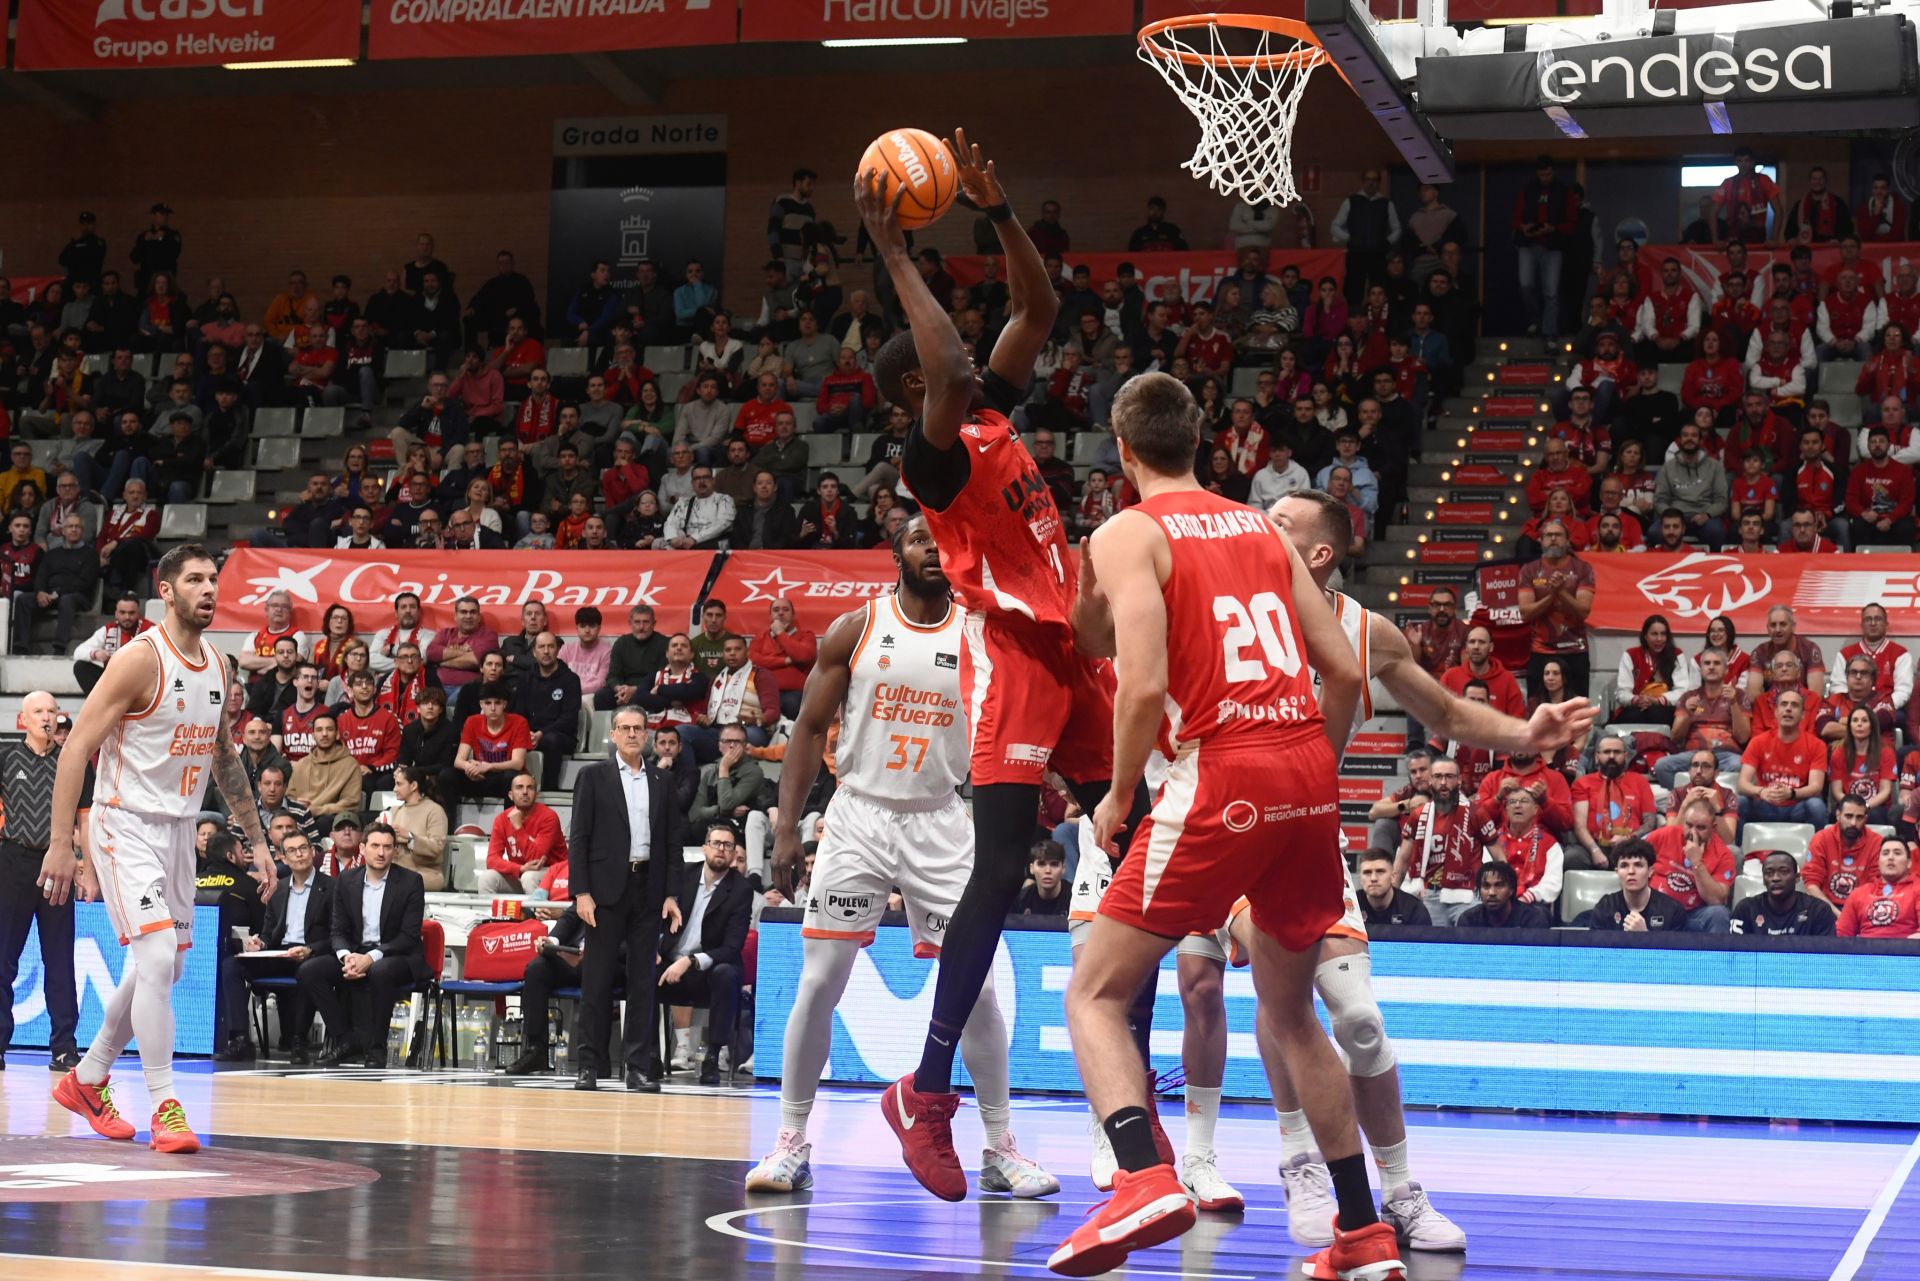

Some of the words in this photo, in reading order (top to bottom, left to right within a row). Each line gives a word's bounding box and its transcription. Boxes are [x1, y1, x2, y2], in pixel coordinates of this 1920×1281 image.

[967, 0, 1049, 27] viajes
[93, 36, 169, 63] Grupo
[175, 30, 276, 55] Helvetia
[1540, 38, 1753, 102] endesa
[562, 125, 639, 146] Grada
[652, 122, 719, 143] Norte
[890, 132, 929, 189] Wilson
[339, 562, 667, 606] CaixaBank
[1486, 579, 1516, 590] MÓDULO
[1497, 592, 1506, 600] 10
[1212, 592, 1302, 683] 20
[255, 646, 276, 657] UCA
[874, 682, 943, 707] Cultura
[941, 698, 958, 709] del
[871, 701, 954, 728] Esfuerzo
[885, 734, 931, 773] 37
[1296, 807, 1307, 816] DE
[1309, 802, 1337, 815] MURCIA
[828, 895, 869, 908] PULEVA
[174, 920, 190, 930] dea
[502, 932, 532, 944] UCAM
